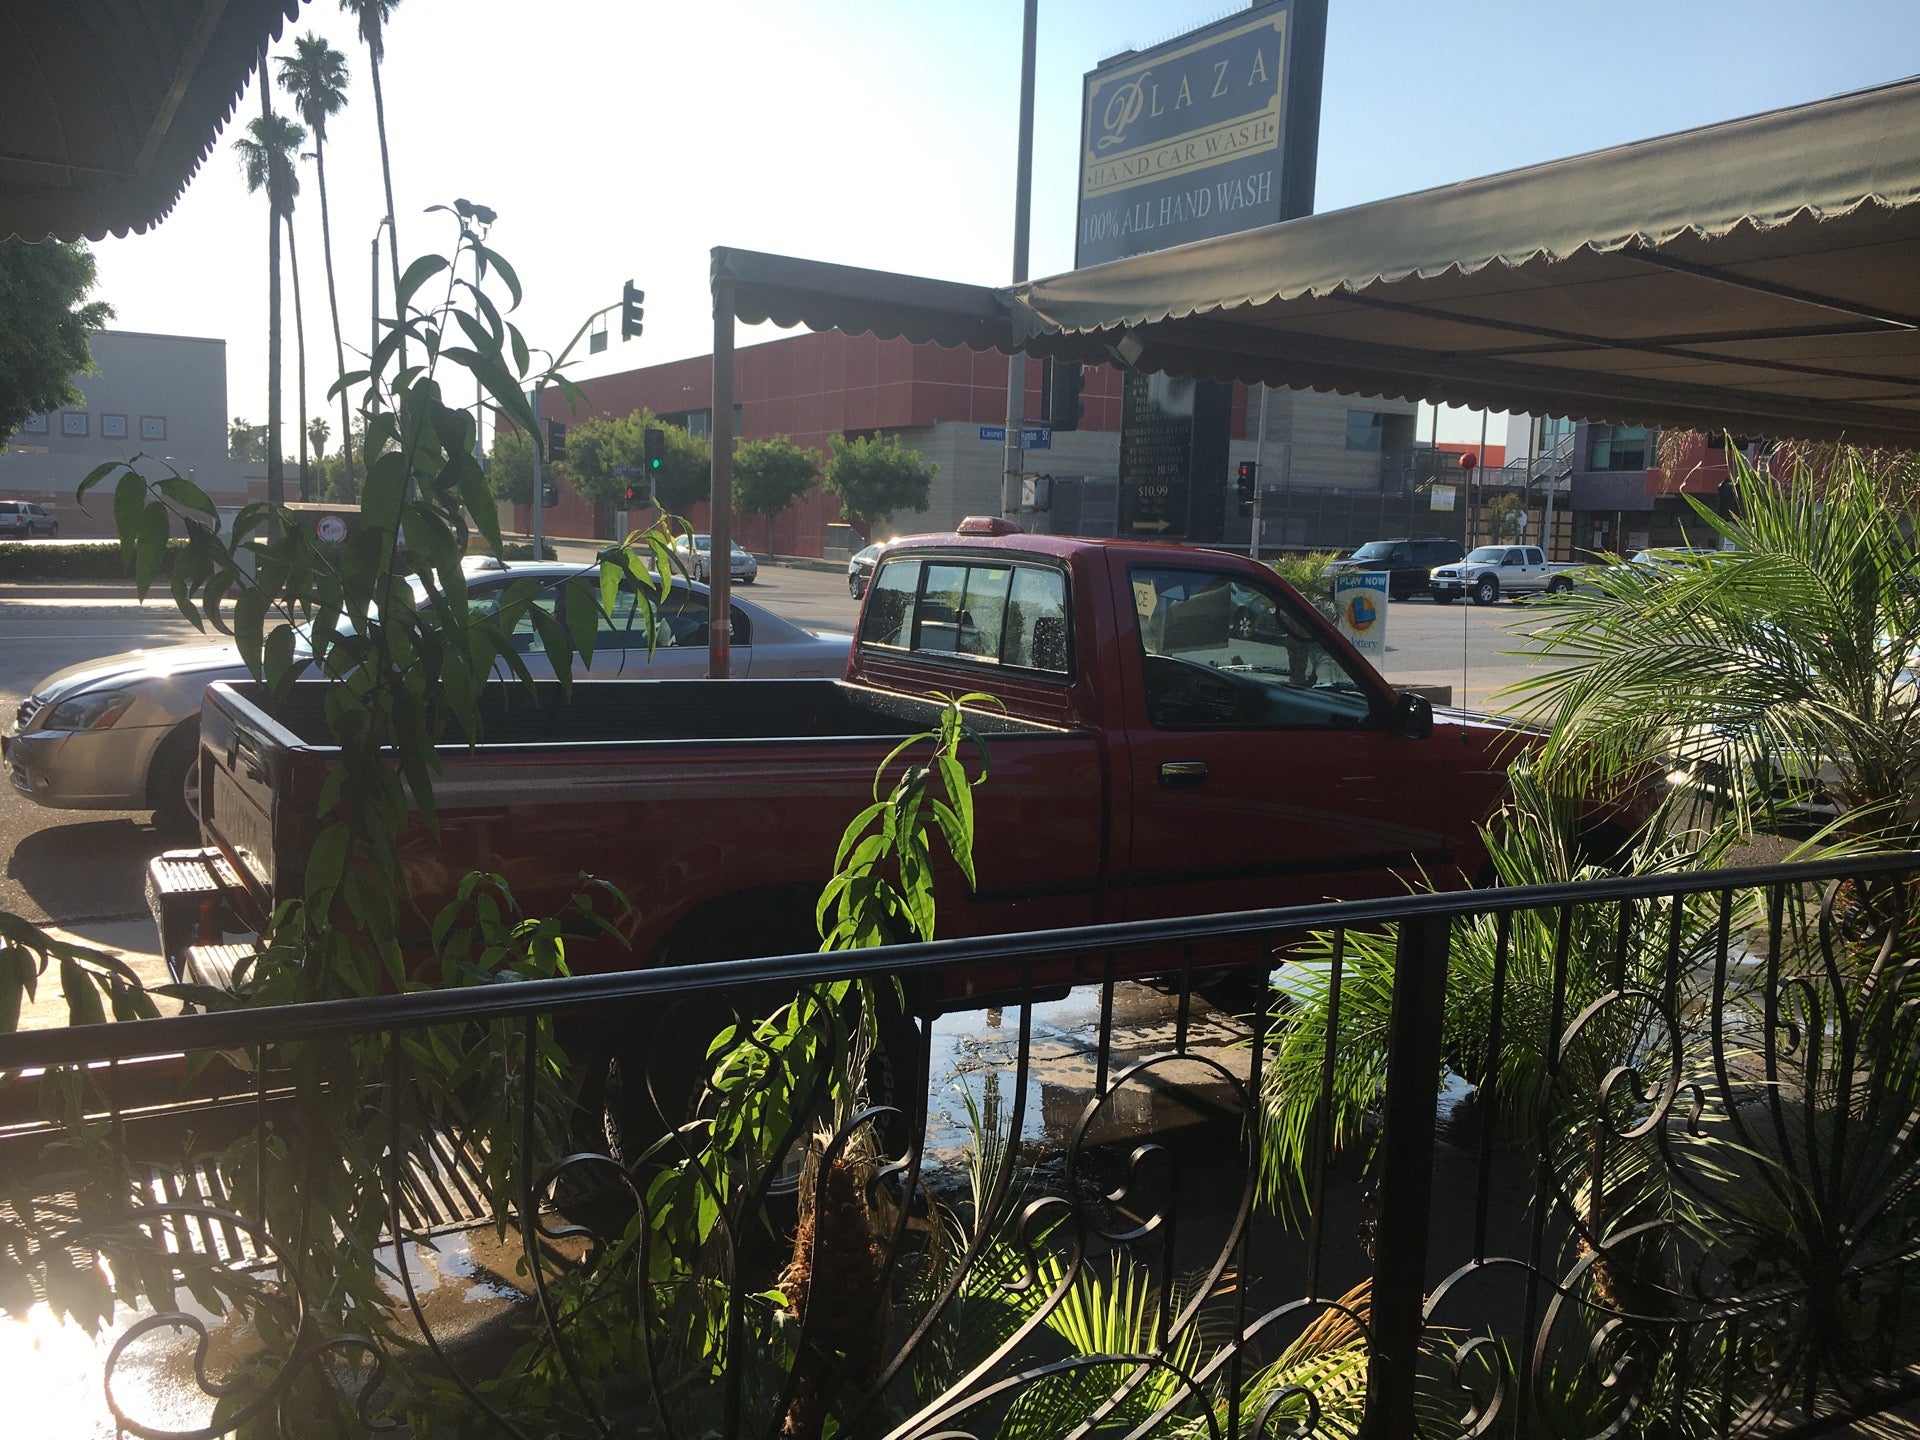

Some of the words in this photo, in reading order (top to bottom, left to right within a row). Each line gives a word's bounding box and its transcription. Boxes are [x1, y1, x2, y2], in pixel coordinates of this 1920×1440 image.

[1097, 47, 1269, 150] PLAZA
[1092, 158, 1150, 185] HAND
[1156, 143, 1197, 167] CAR
[1204, 122, 1267, 155] WASH
[1083, 208, 1119, 244] 100%
[1121, 201, 1155, 236] ALL
[1158, 187, 1211, 228] HAND
[1216, 170, 1273, 210] WASH
[982, 429, 1003, 438] Laurel
[1042, 430, 1048, 441] St
[1138, 484, 1168, 497] $10.99
[1339, 576, 1362, 587] PLAY
[1365, 577, 1386, 586] NOW
